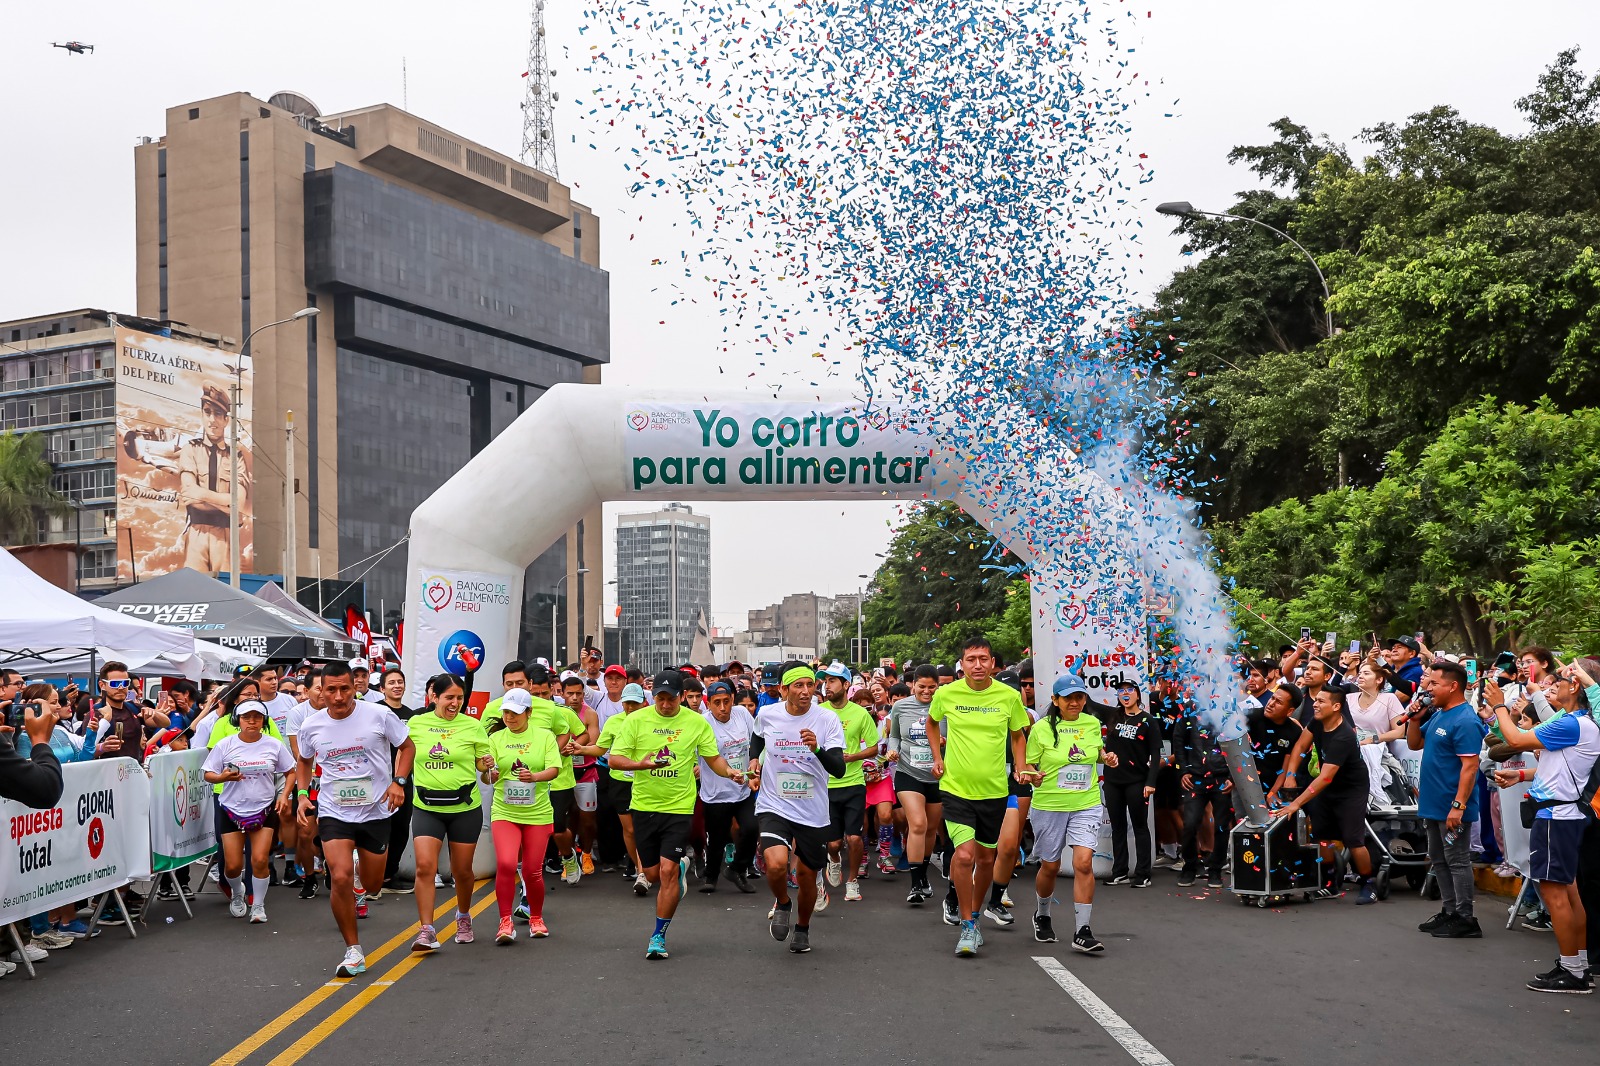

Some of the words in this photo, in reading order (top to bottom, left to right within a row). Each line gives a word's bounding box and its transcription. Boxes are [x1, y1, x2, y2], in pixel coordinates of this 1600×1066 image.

[122, 345, 166, 365] FUERZA
[167, 355, 203, 373] AÉREA
[122, 365, 145, 380] DEL
[147, 370, 175, 385] PERÚ
[693, 409, 740, 448] Yo
[751, 416, 860, 448] corro
[632, 456, 727, 490] para
[738, 446, 930, 484] alimentar
[456, 580, 494, 592] BANCO
[495, 584, 507, 594] DE
[455, 591, 510, 605] ALIMENTOS
[117, 603, 210, 614] POWER
[454, 601, 481, 613] PERÚ
[219, 635, 268, 647] POWER
[955, 705, 1000, 714] amazonlogistics
[1115, 722, 1139, 732] OWER
[424, 761, 454, 770] GUIDE
[650, 769, 679, 778] GUIDE
[1066, 772, 1086, 781] 0311
[782, 781, 808, 790] 0244
[340, 788, 366, 798] 0106
[507, 788, 531, 797] 0332
[77, 788, 115, 826] GLORIA
[10, 807, 63, 846] apuesta
[19, 838, 52, 875] total
[2, 897, 11, 909] Se
[11, 893, 32, 906] suman
[37, 885, 44, 898] la
[45, 879, 64, 895] lucha
[64, 873, 86, 889] contra
[87, 871, 93, 882] el
[93, 864, 117, 880] hambre
